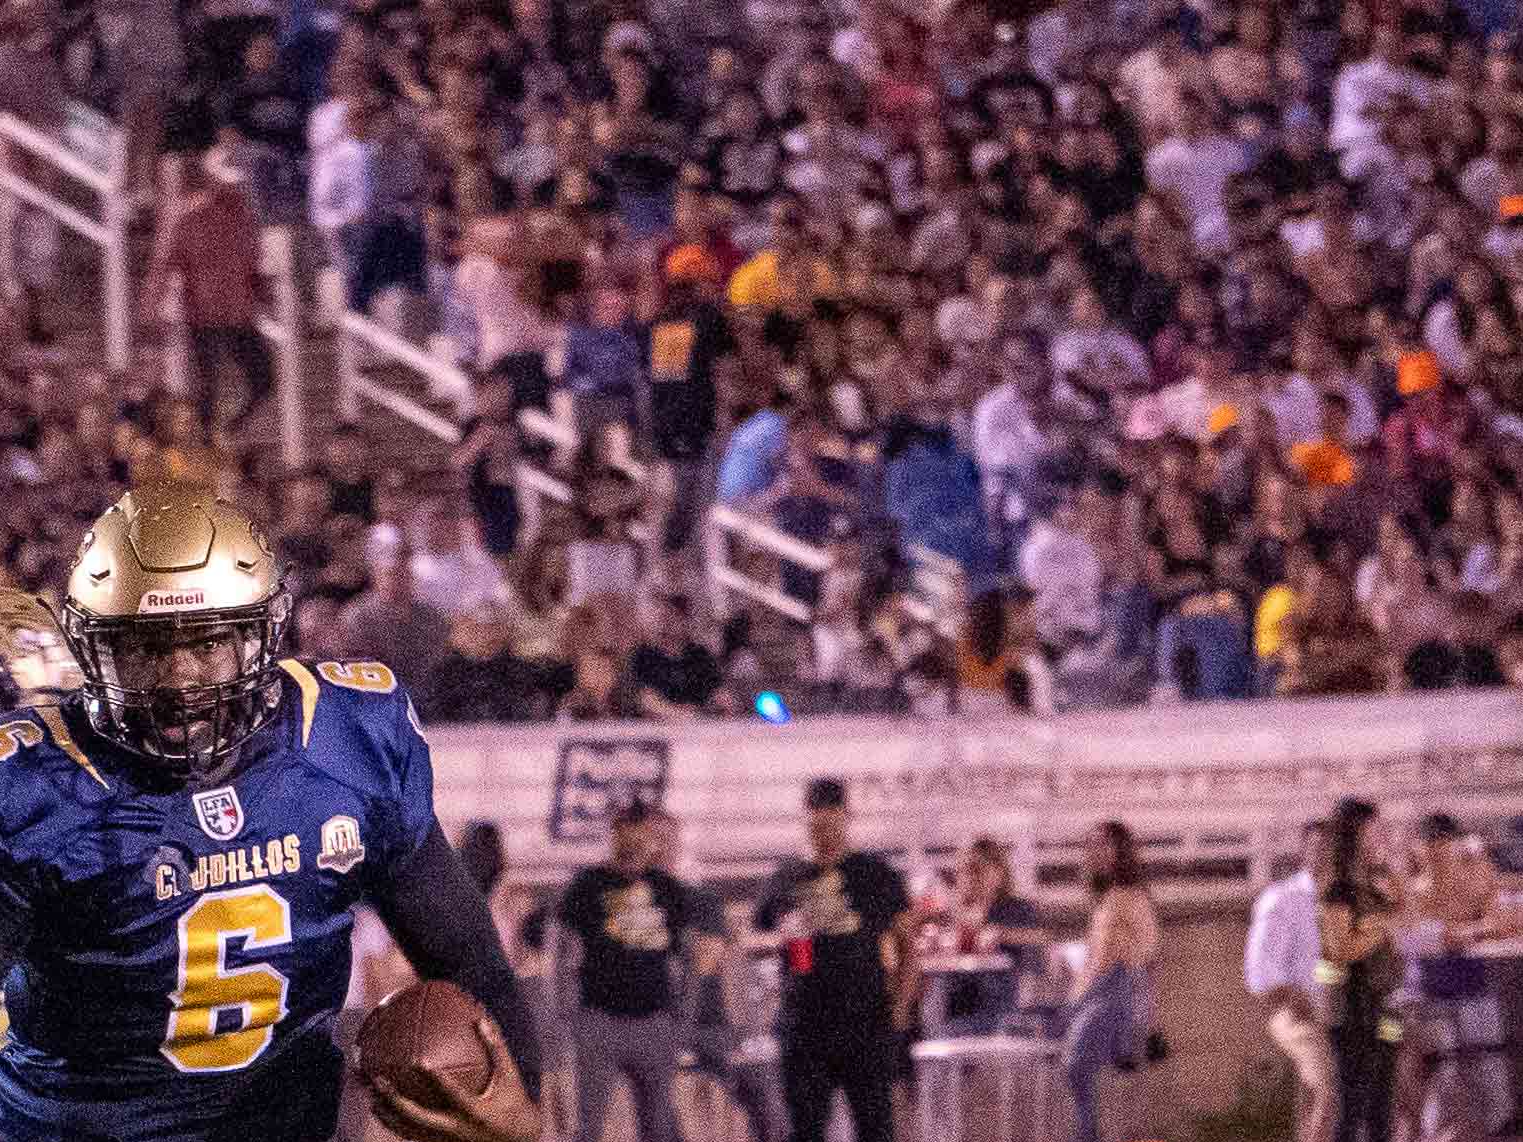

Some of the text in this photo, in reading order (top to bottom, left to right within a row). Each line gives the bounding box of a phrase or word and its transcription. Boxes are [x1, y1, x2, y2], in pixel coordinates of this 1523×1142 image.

[147, 592, 204, 606] Riddell
[155, 833, 301, 900] CUDILLOS
[161, 883, 290, 1073] 6
